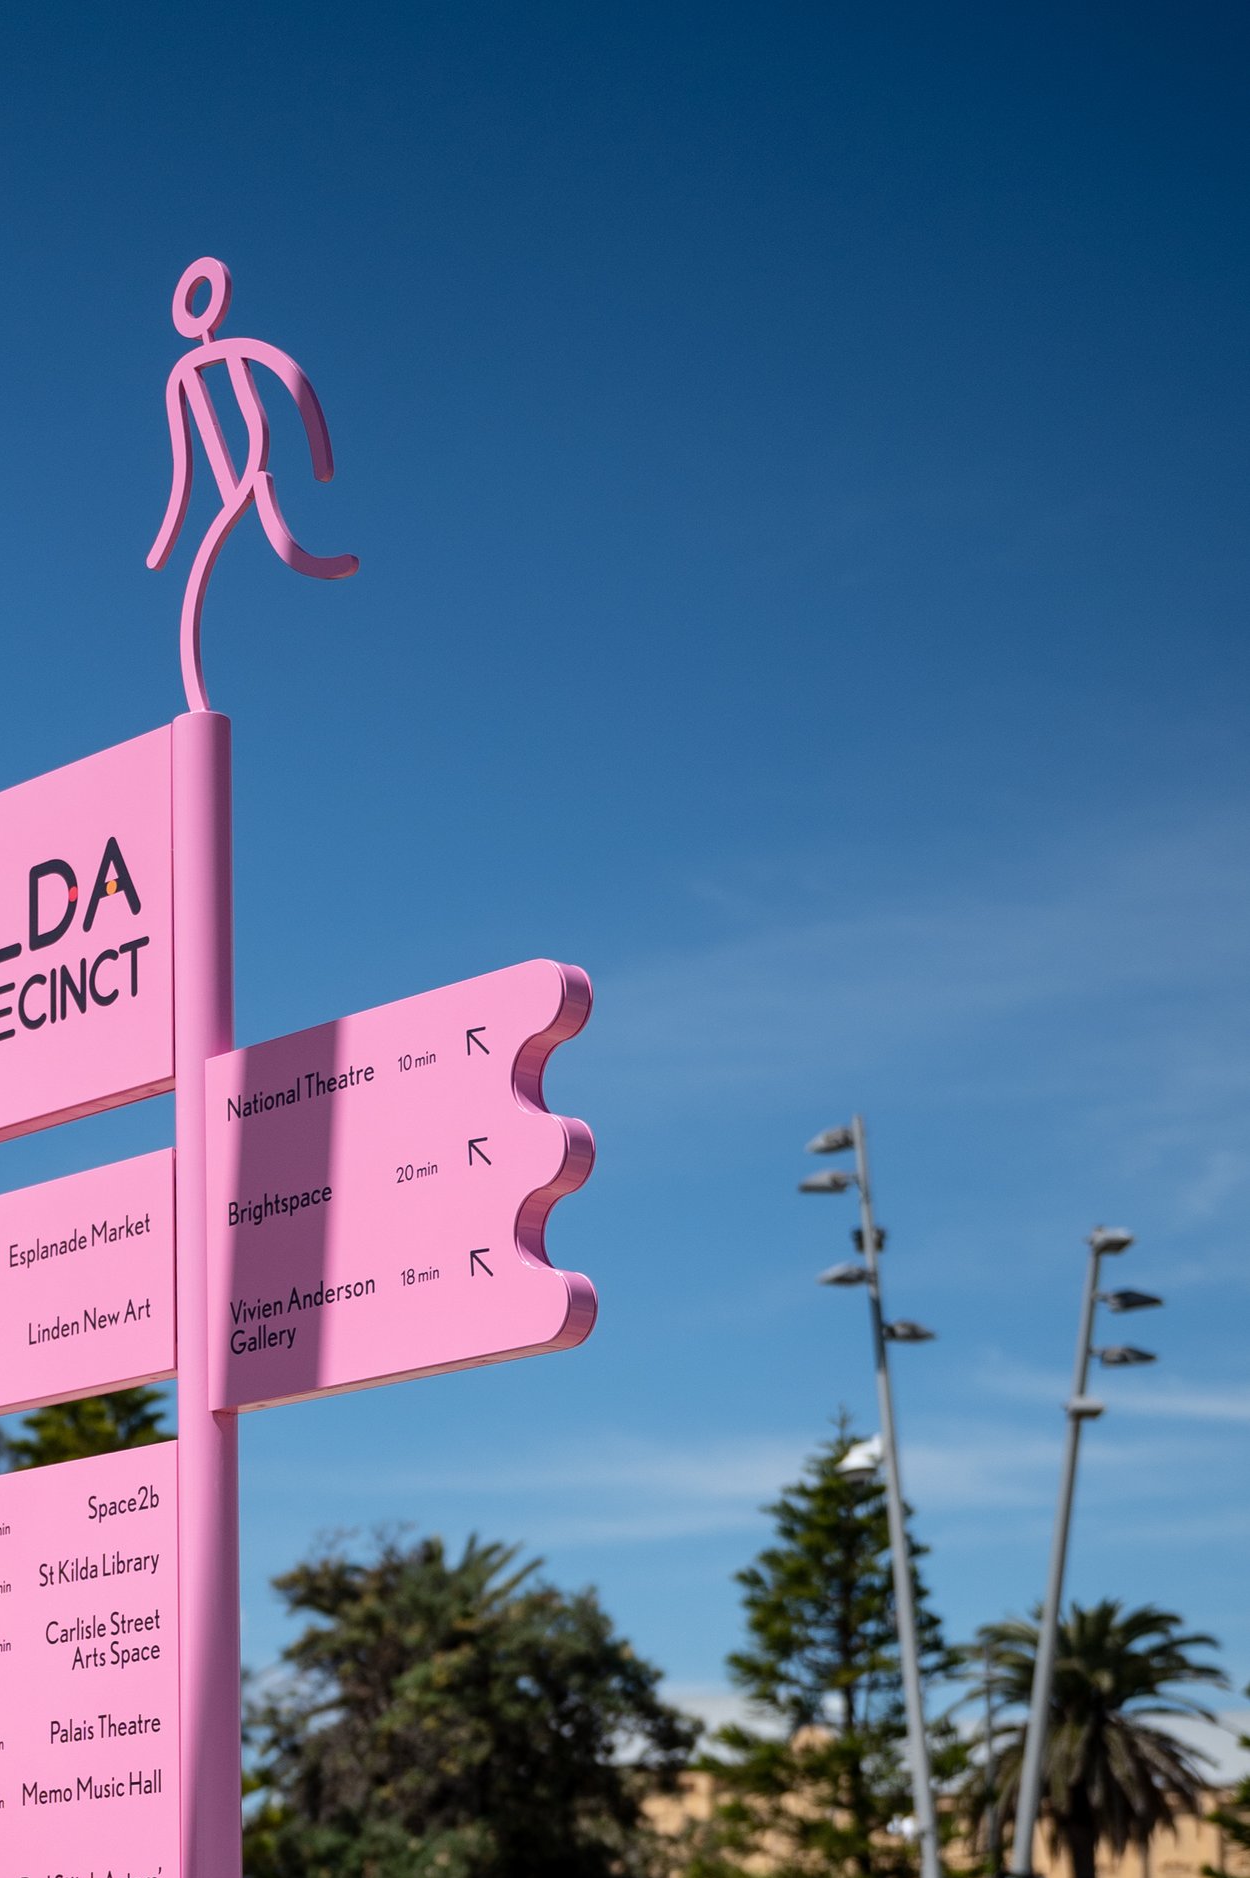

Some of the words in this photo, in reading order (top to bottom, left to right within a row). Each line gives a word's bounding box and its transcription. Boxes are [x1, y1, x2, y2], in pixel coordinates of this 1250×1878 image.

[398, 1056, 411, 1073] 10
[414, 1051, 436, 1069] min
[227, 1078, 300, 1122] National
[305, 1065, 374, 1101] Theatre
[396, 1166, 413, 1184] 20
[416, 1162, 438, 1178] min
[228, 1185, 332, 1227] Brightspace
[9, 1229, 87, 1268] Esplanade
[91, 1213, 151, 1247] Market
[401, 1269, 415, 1287] 18
[418, 1266, 440, 1283] min
[230, 1297, 283, 1326] Vivien
[287, 1277, 376, 1313] Anderson
[28, 1316, 79, 1345] Linden
[84, 1307, 120, 1333] New
[124, 1298, 151, 1324] Art
[230, 1324, 296, 1355] Gallery
[39, 1564, 55, 1587] St
[58, 1556, 98, 1584] Kilda
[102, 1551, 160, 1578] Library
[45, 1615, 106, 1645] Carlisle
[110, 1609, 160, 1637] Street
[71, 1646, 106, 1671] Arts
[110, 1640, 161, 1669] Space
[50, 1719, 94, 1745] Palais
[98, 1713, 161, 1739] Theatre
[22, 1782, 73, 1806] Memo
[76, 1776, 125, 1801] Music
[129, 1769, 162, 1796] Hall
